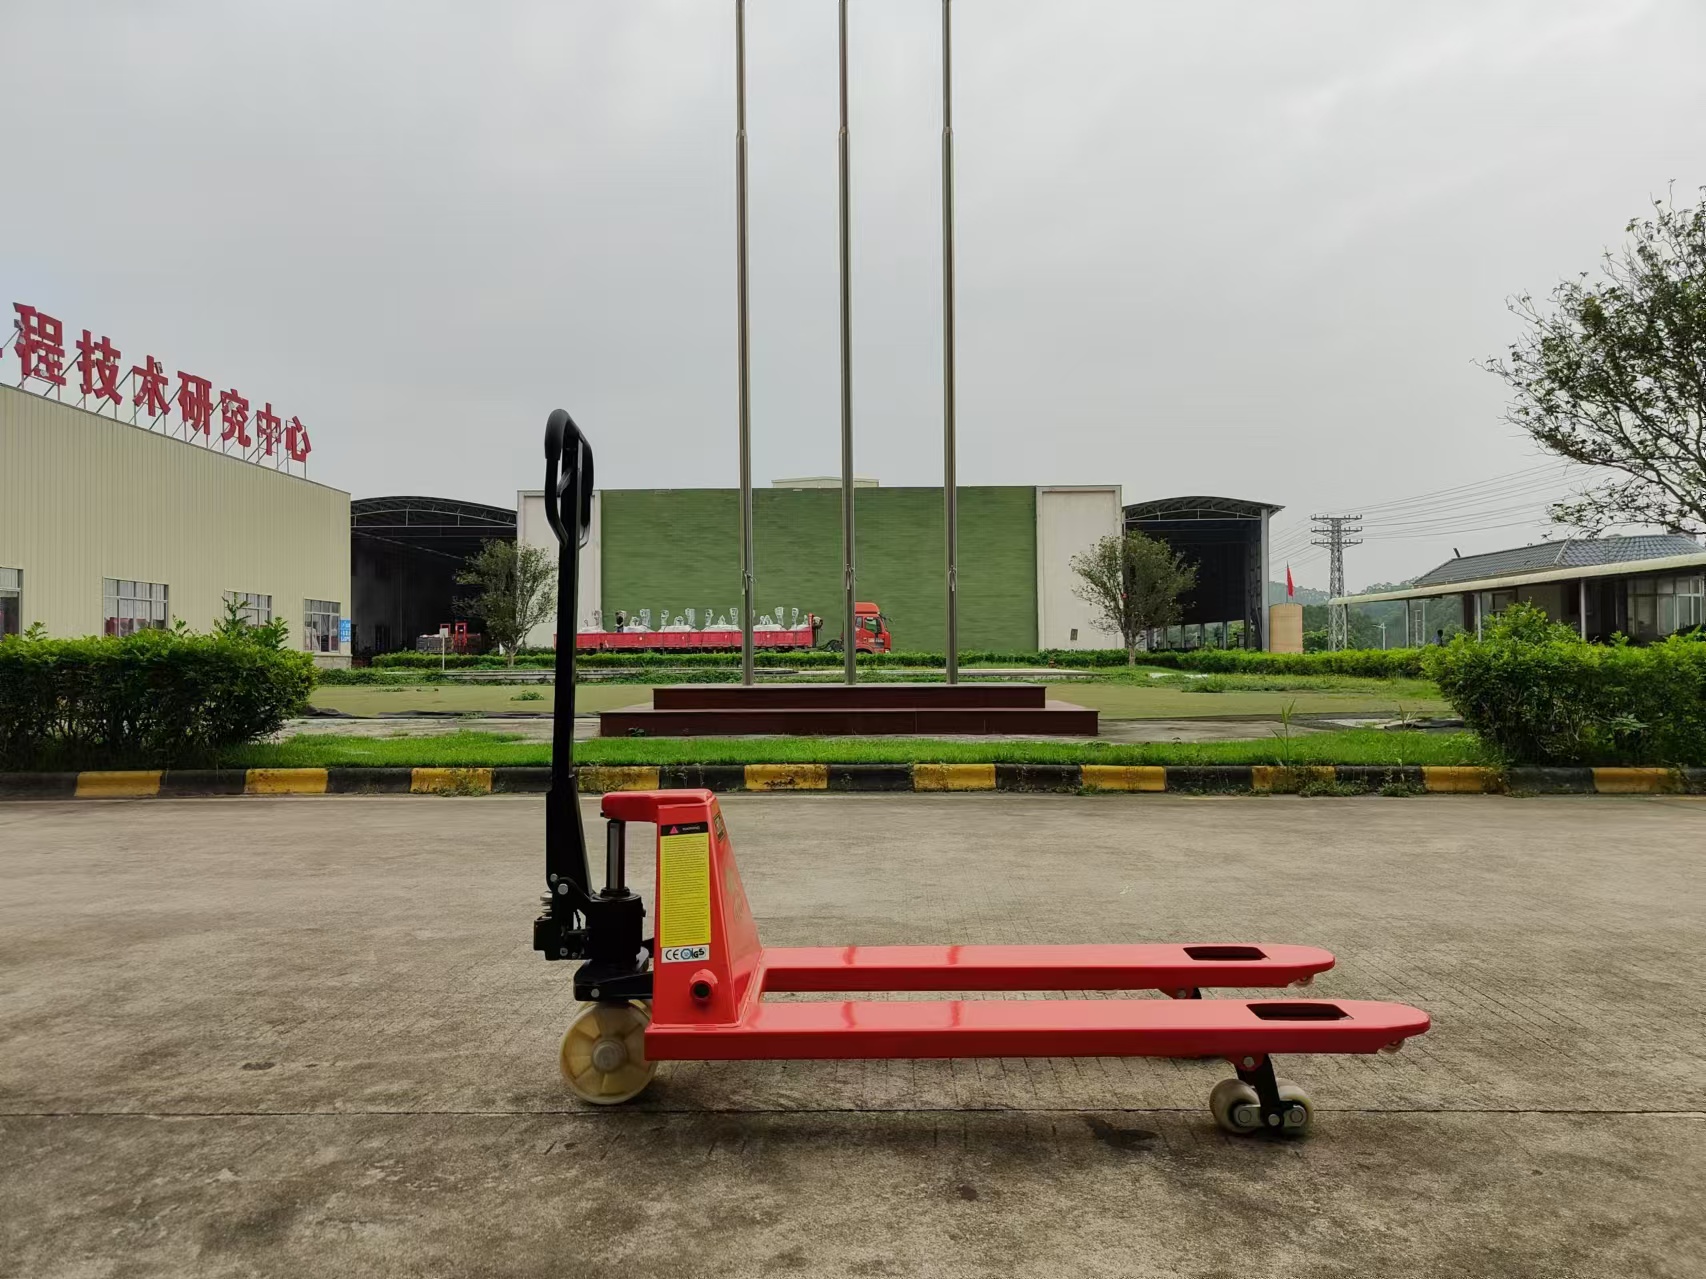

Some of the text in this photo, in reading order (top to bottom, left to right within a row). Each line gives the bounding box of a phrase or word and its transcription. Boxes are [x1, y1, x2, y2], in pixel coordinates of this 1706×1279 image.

[0, 302, 311, 462] 程技术研究中心
[665, 949, 679, 960] CE
